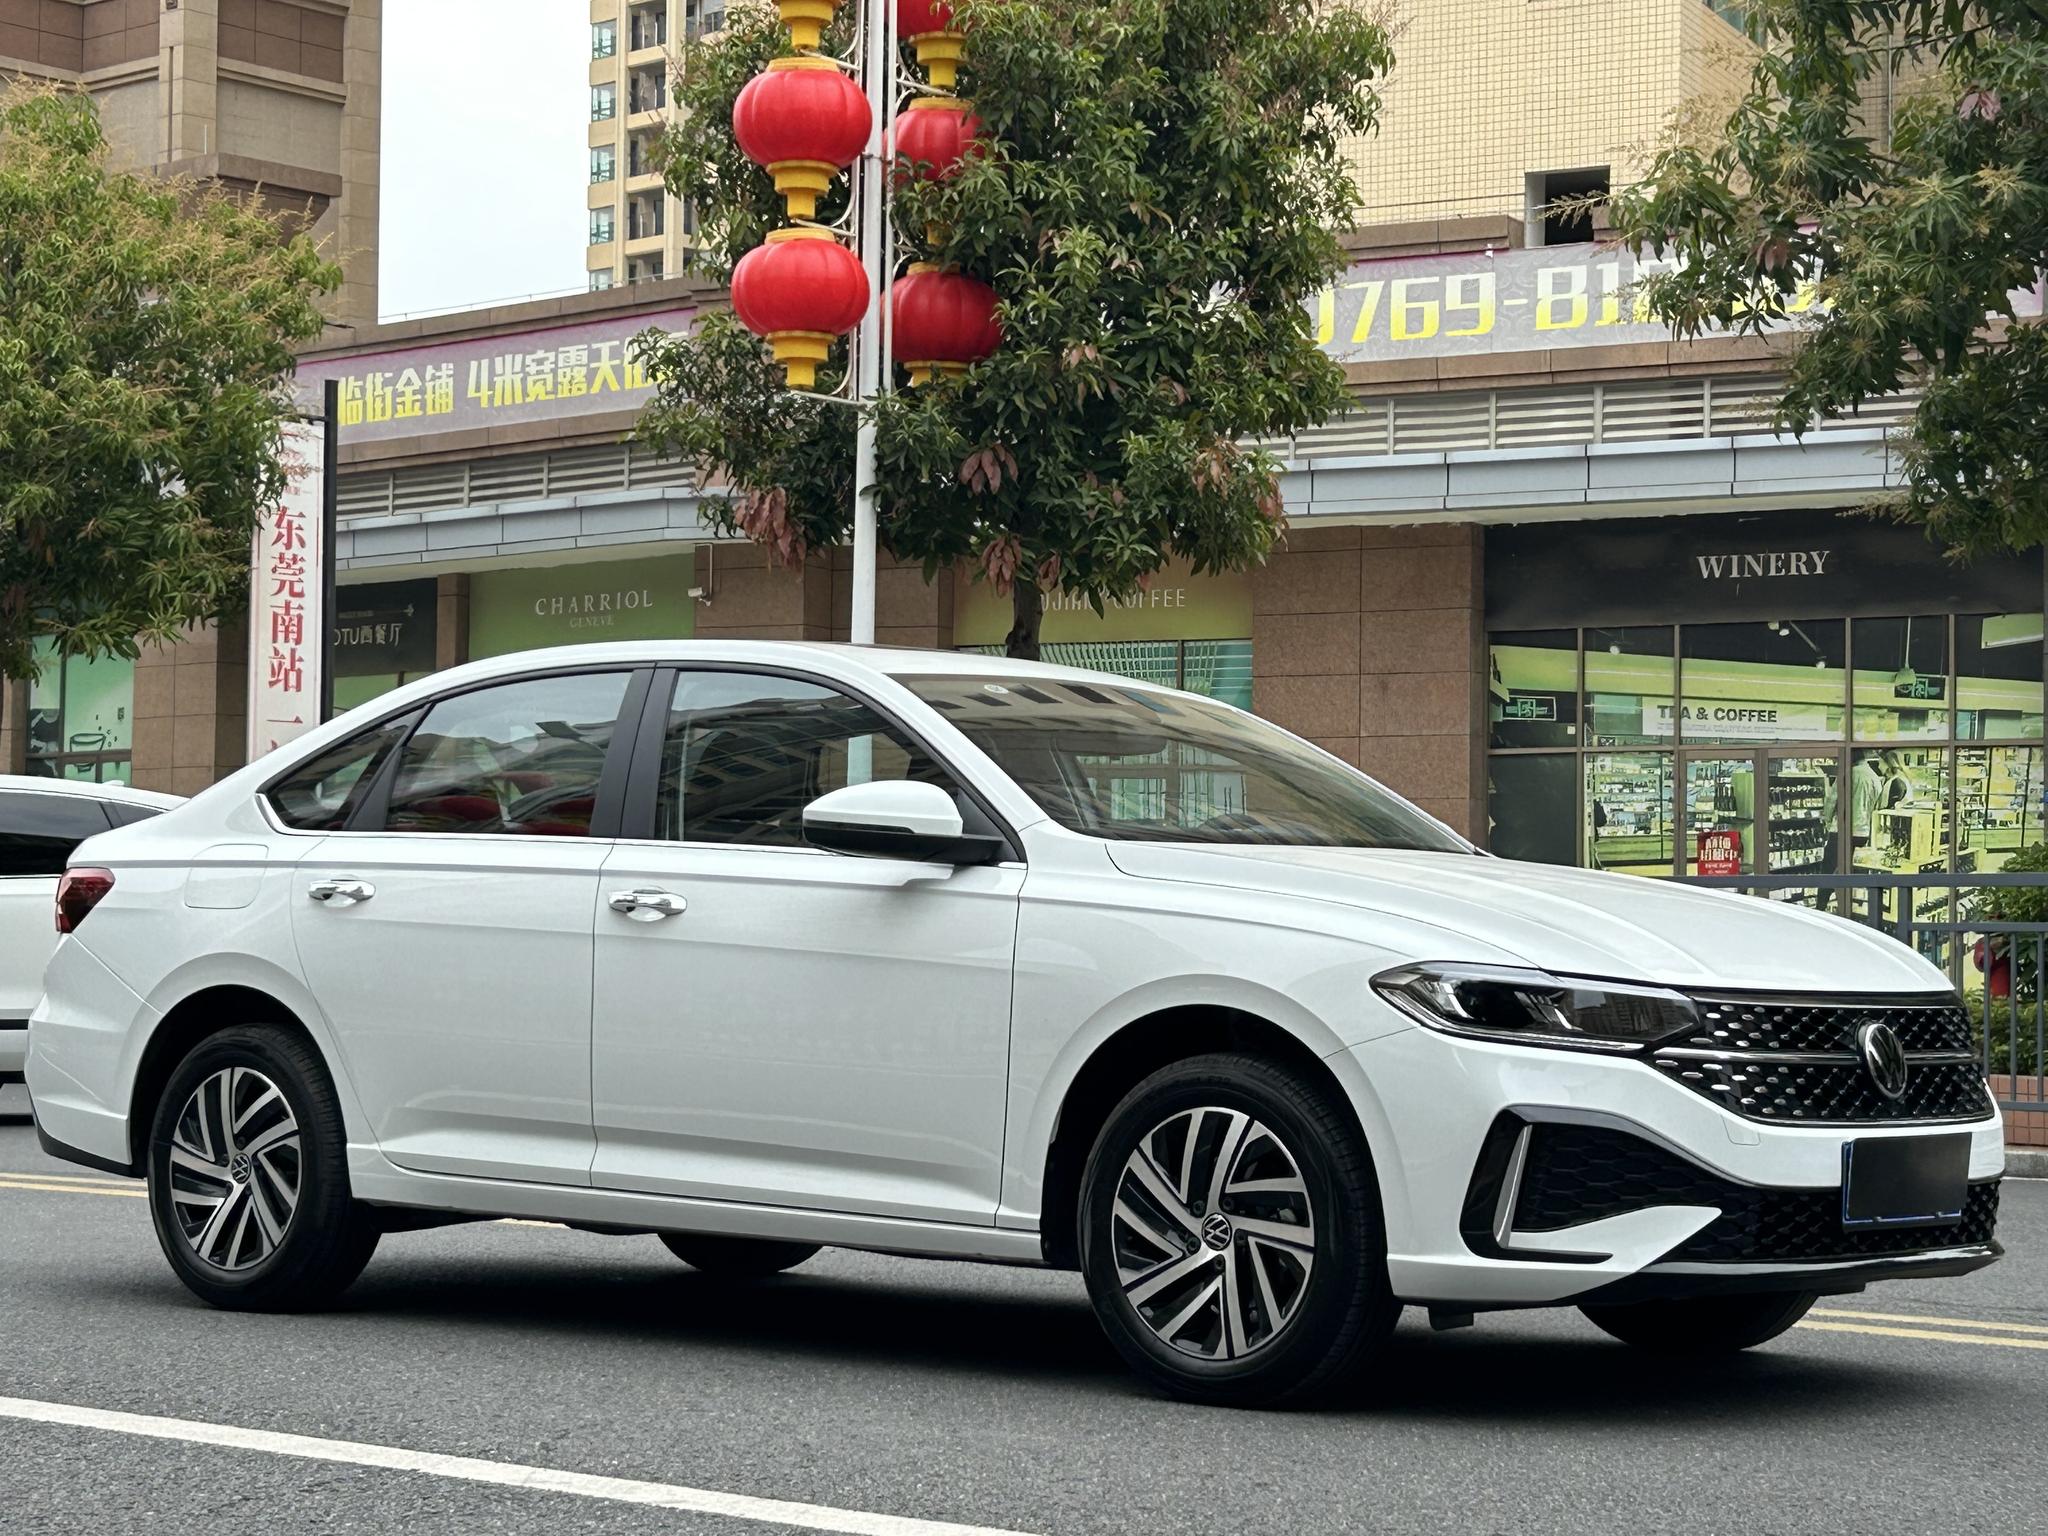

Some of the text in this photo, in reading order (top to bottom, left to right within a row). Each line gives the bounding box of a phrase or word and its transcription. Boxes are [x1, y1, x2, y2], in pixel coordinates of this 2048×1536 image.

[1696, 550, 1830, 579] WINERY
[535, 590, 653, 615] CHARRIOL
[1696, 706, 1709, 720] &
[1713, 708, 1777, 723] COFFEE
